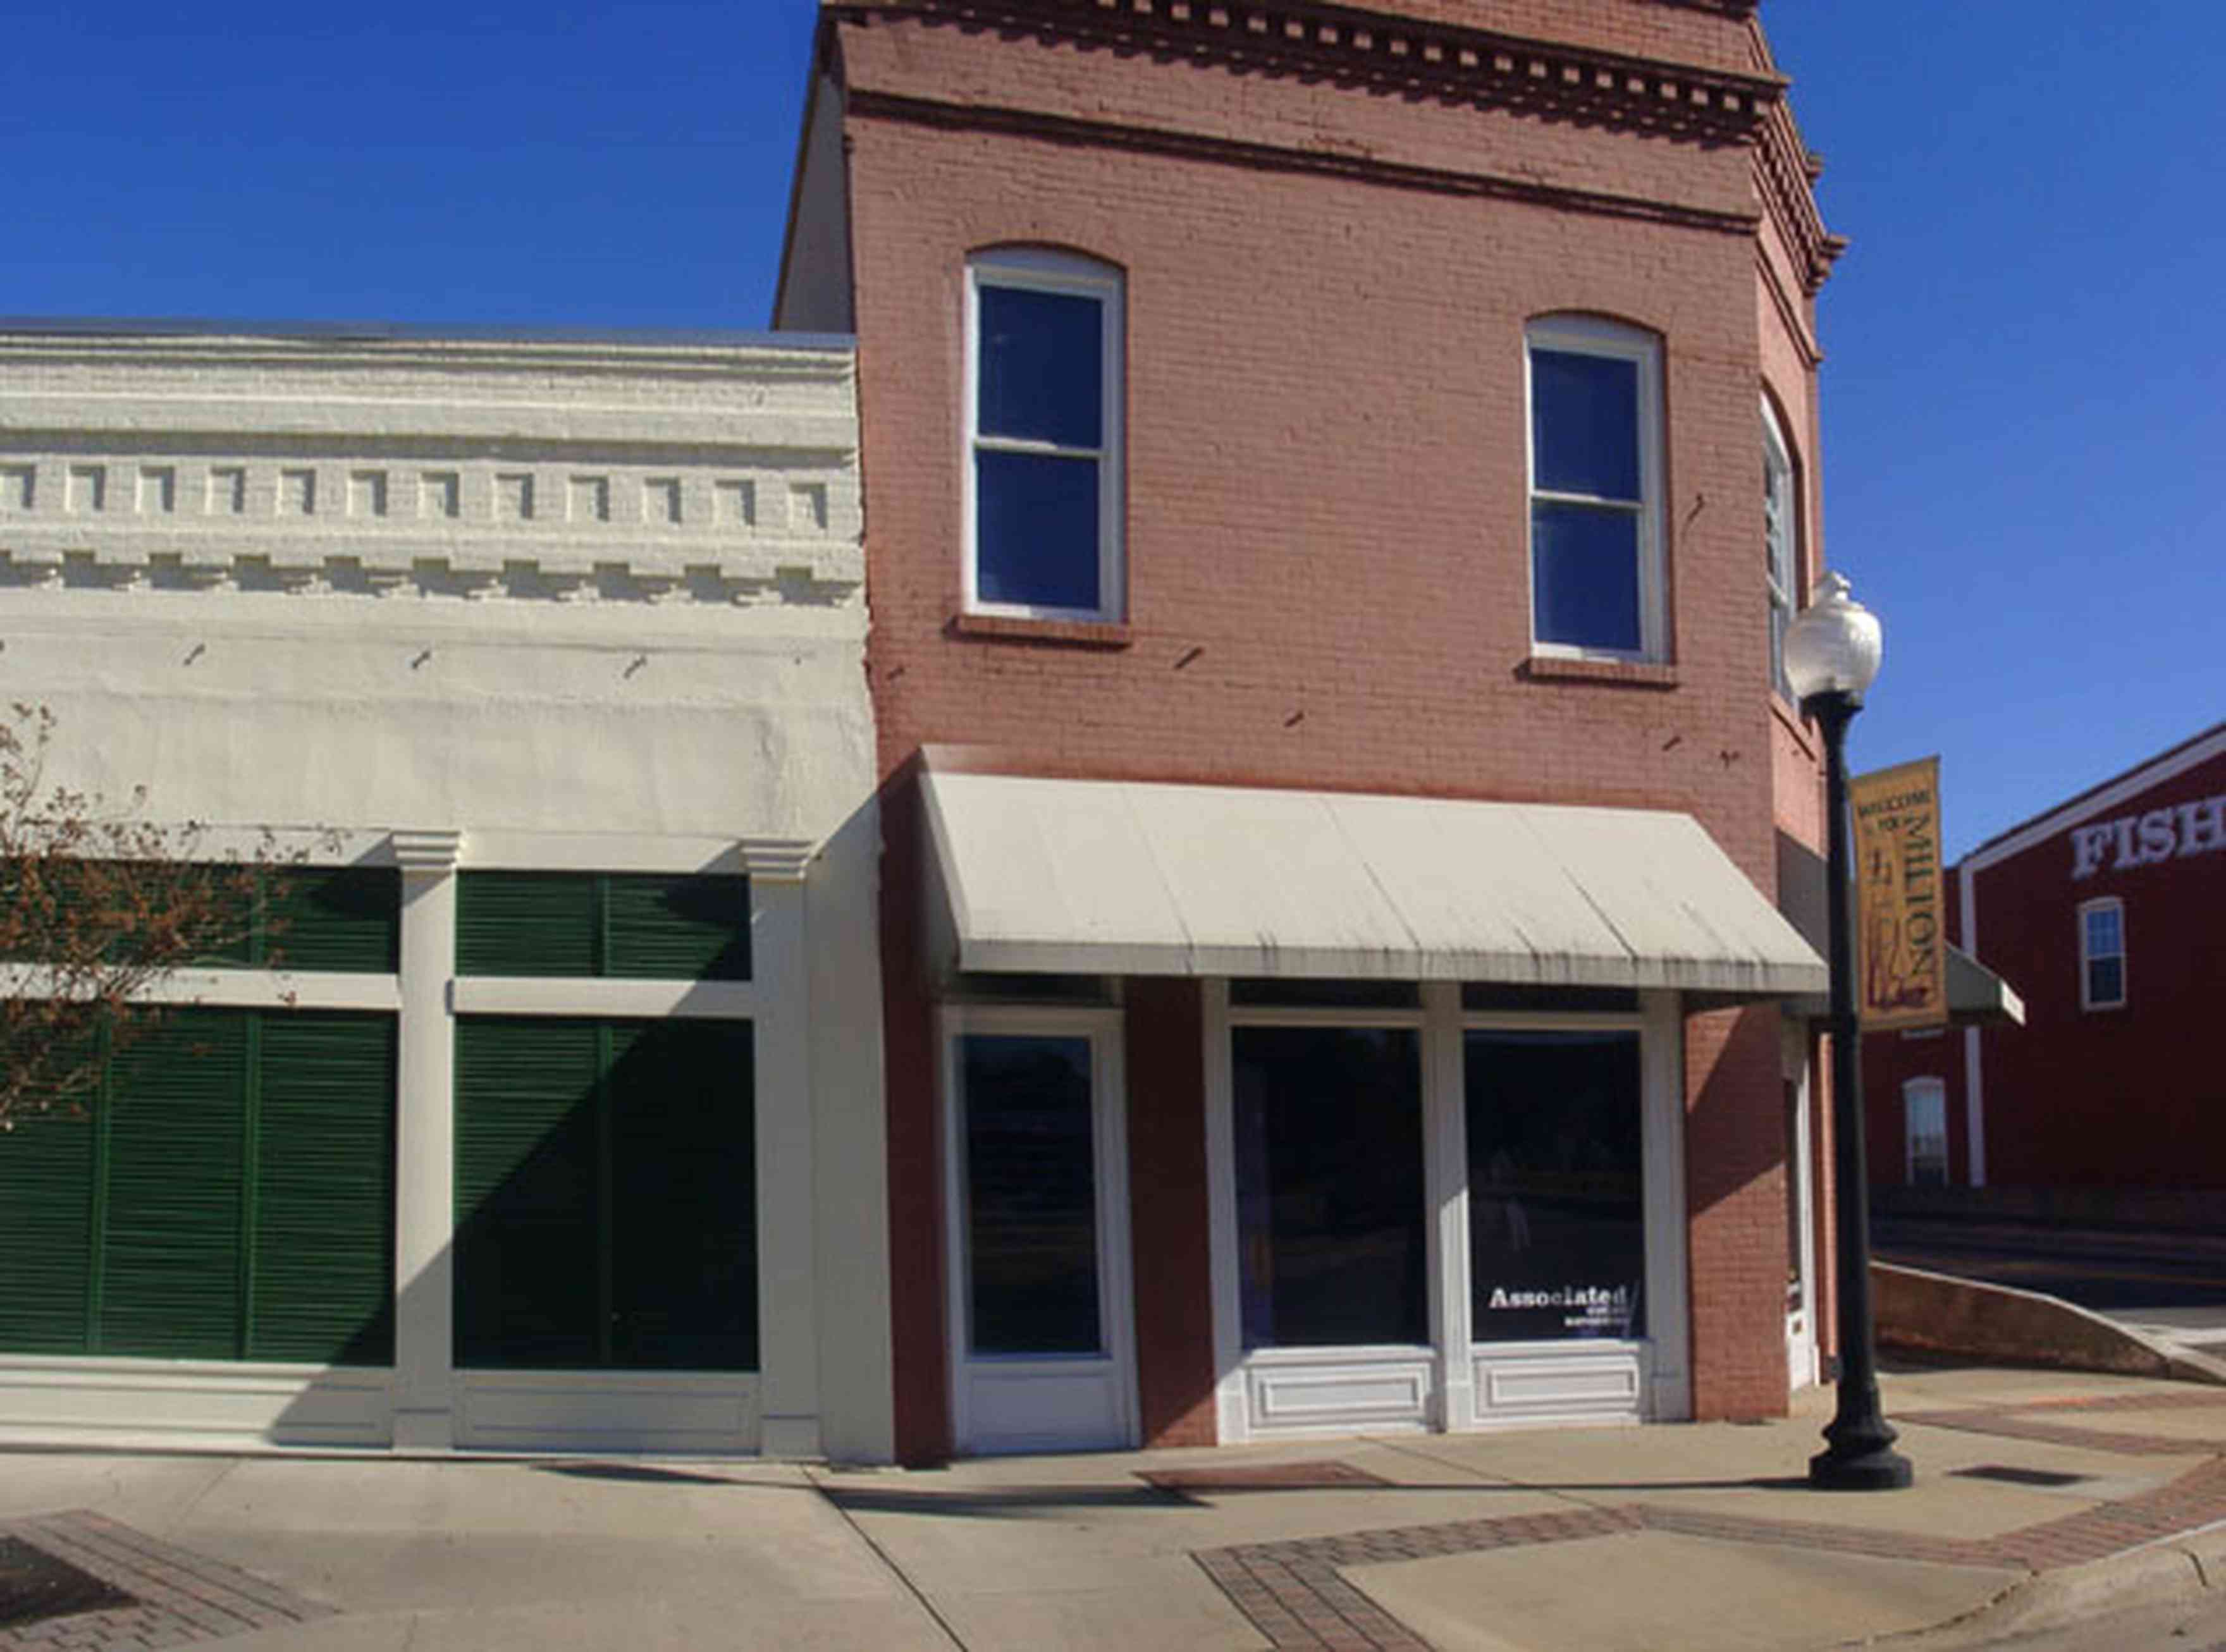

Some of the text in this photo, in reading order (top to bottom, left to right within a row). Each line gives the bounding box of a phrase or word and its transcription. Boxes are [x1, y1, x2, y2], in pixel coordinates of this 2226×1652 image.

[1857, 791, 1931, 817] WELCOME
[2070, 795, 2226, 879] FISH
[1903, 812, 1936, 976] MILTON
[1489, 1286, 1627, 1308] Associated
